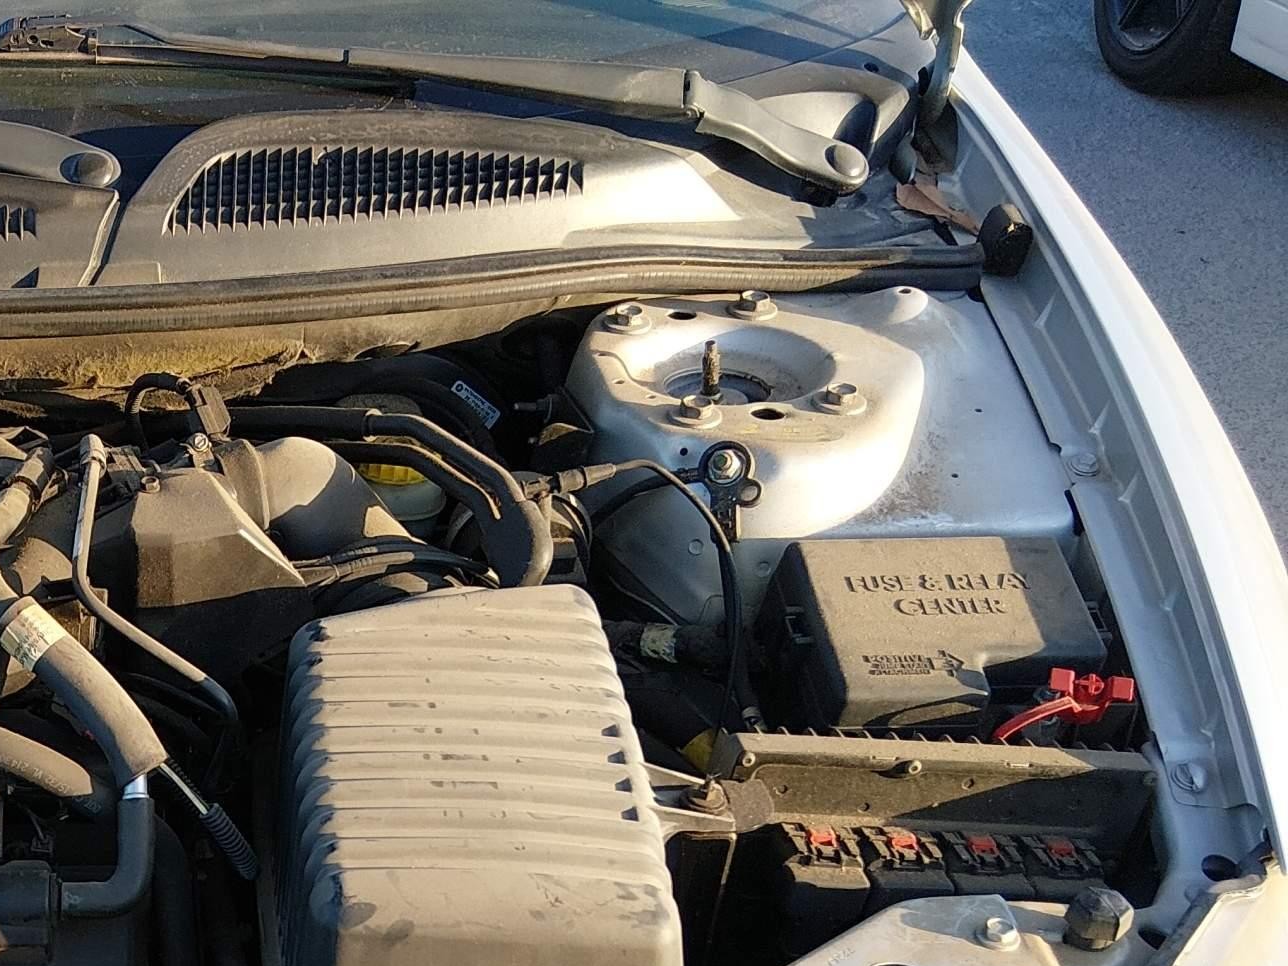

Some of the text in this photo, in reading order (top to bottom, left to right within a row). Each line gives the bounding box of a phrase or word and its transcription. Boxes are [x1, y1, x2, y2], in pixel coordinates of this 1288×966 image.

[844, 572, 1032, 593] FUSE & RELAY
[893, 597, 1008, 616] CENTER
